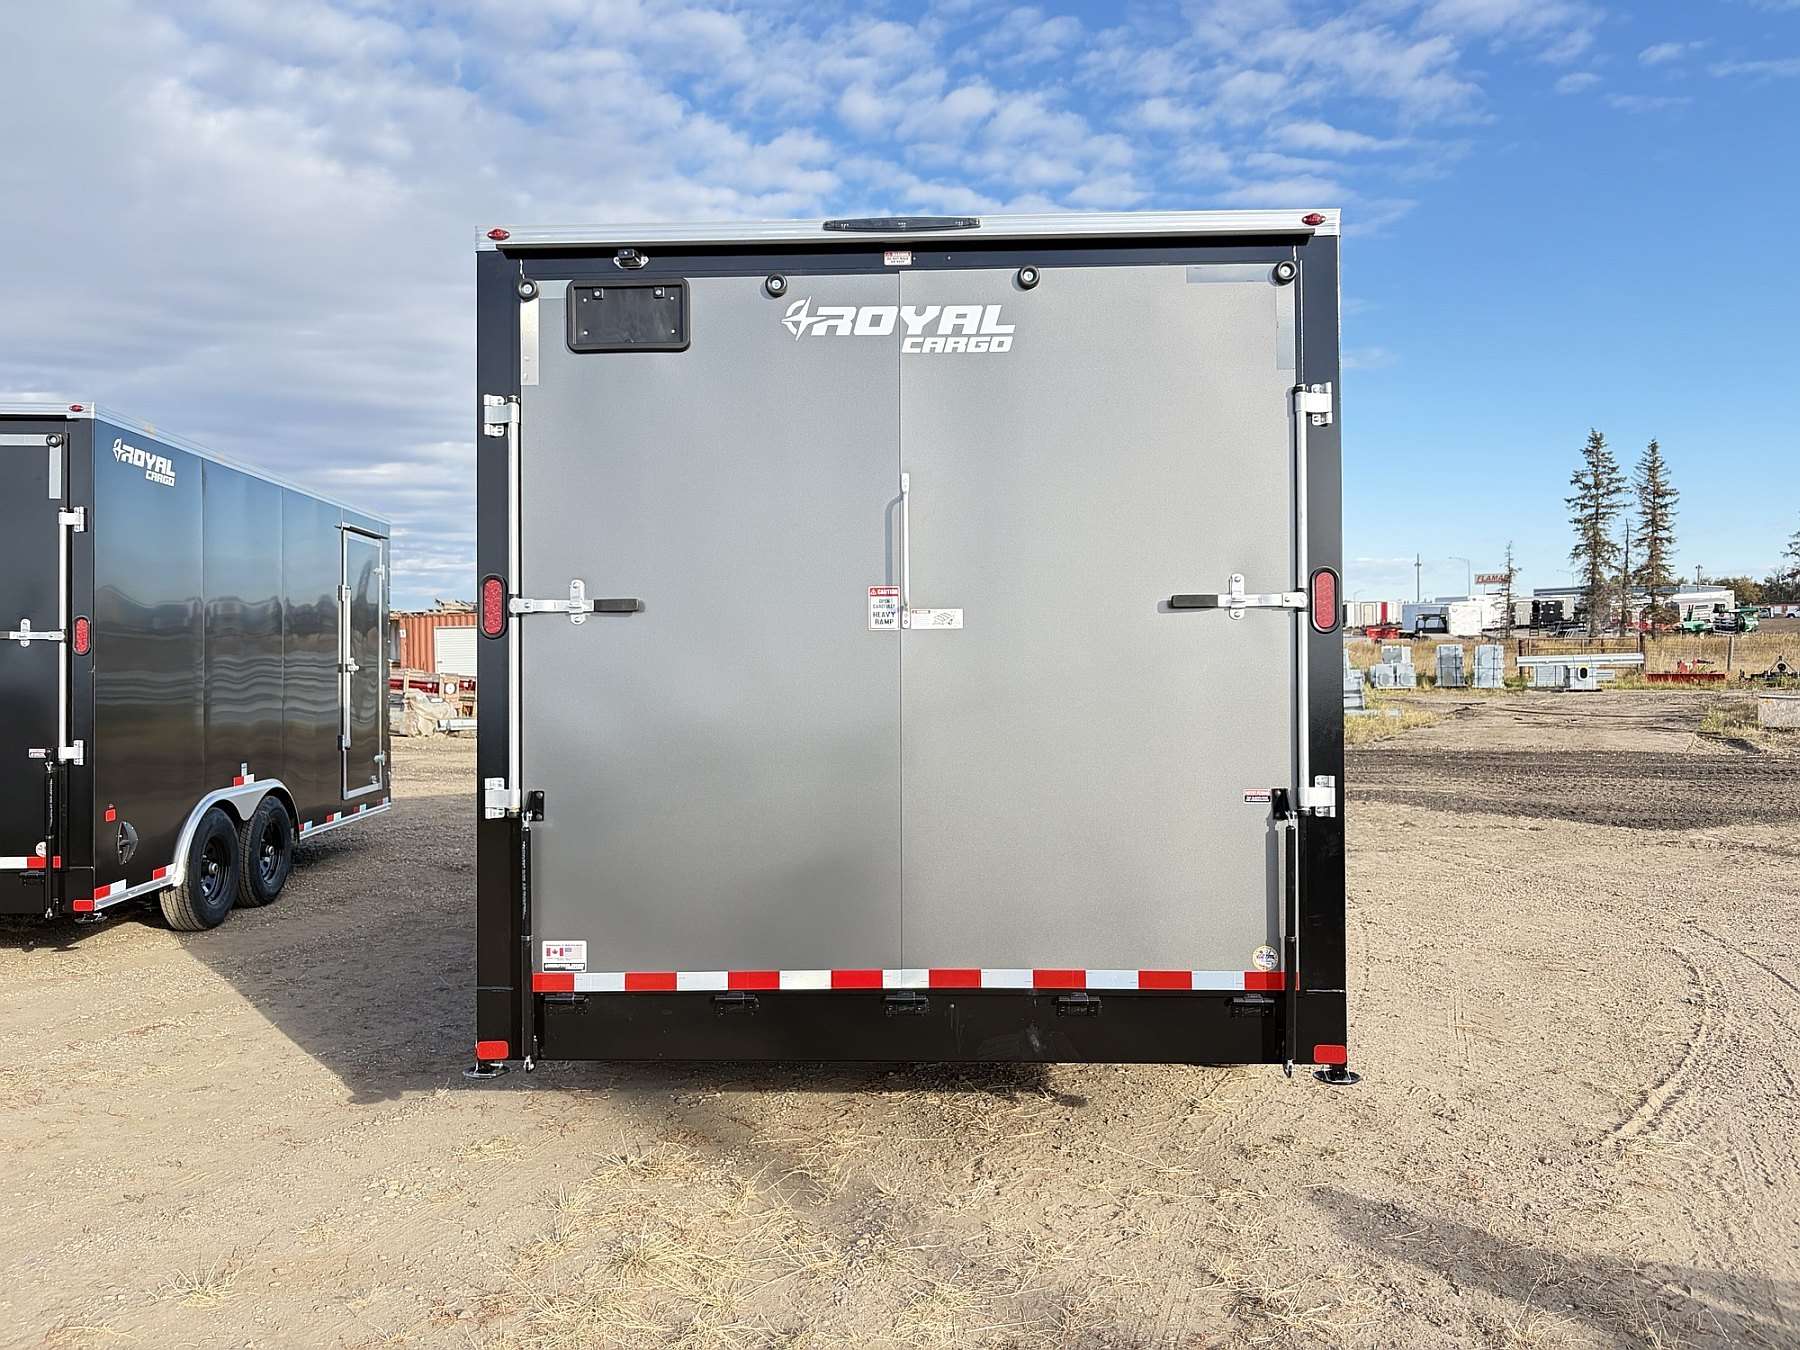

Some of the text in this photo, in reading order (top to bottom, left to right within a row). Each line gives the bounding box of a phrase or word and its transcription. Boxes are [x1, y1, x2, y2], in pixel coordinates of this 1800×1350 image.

[811, 304, 1016, 336] ROYAL
[901, 336, 1014, 353] CARGO
[120, 444, 176, 478] ROYAL
[145, 470, 175, 487] CARGO
